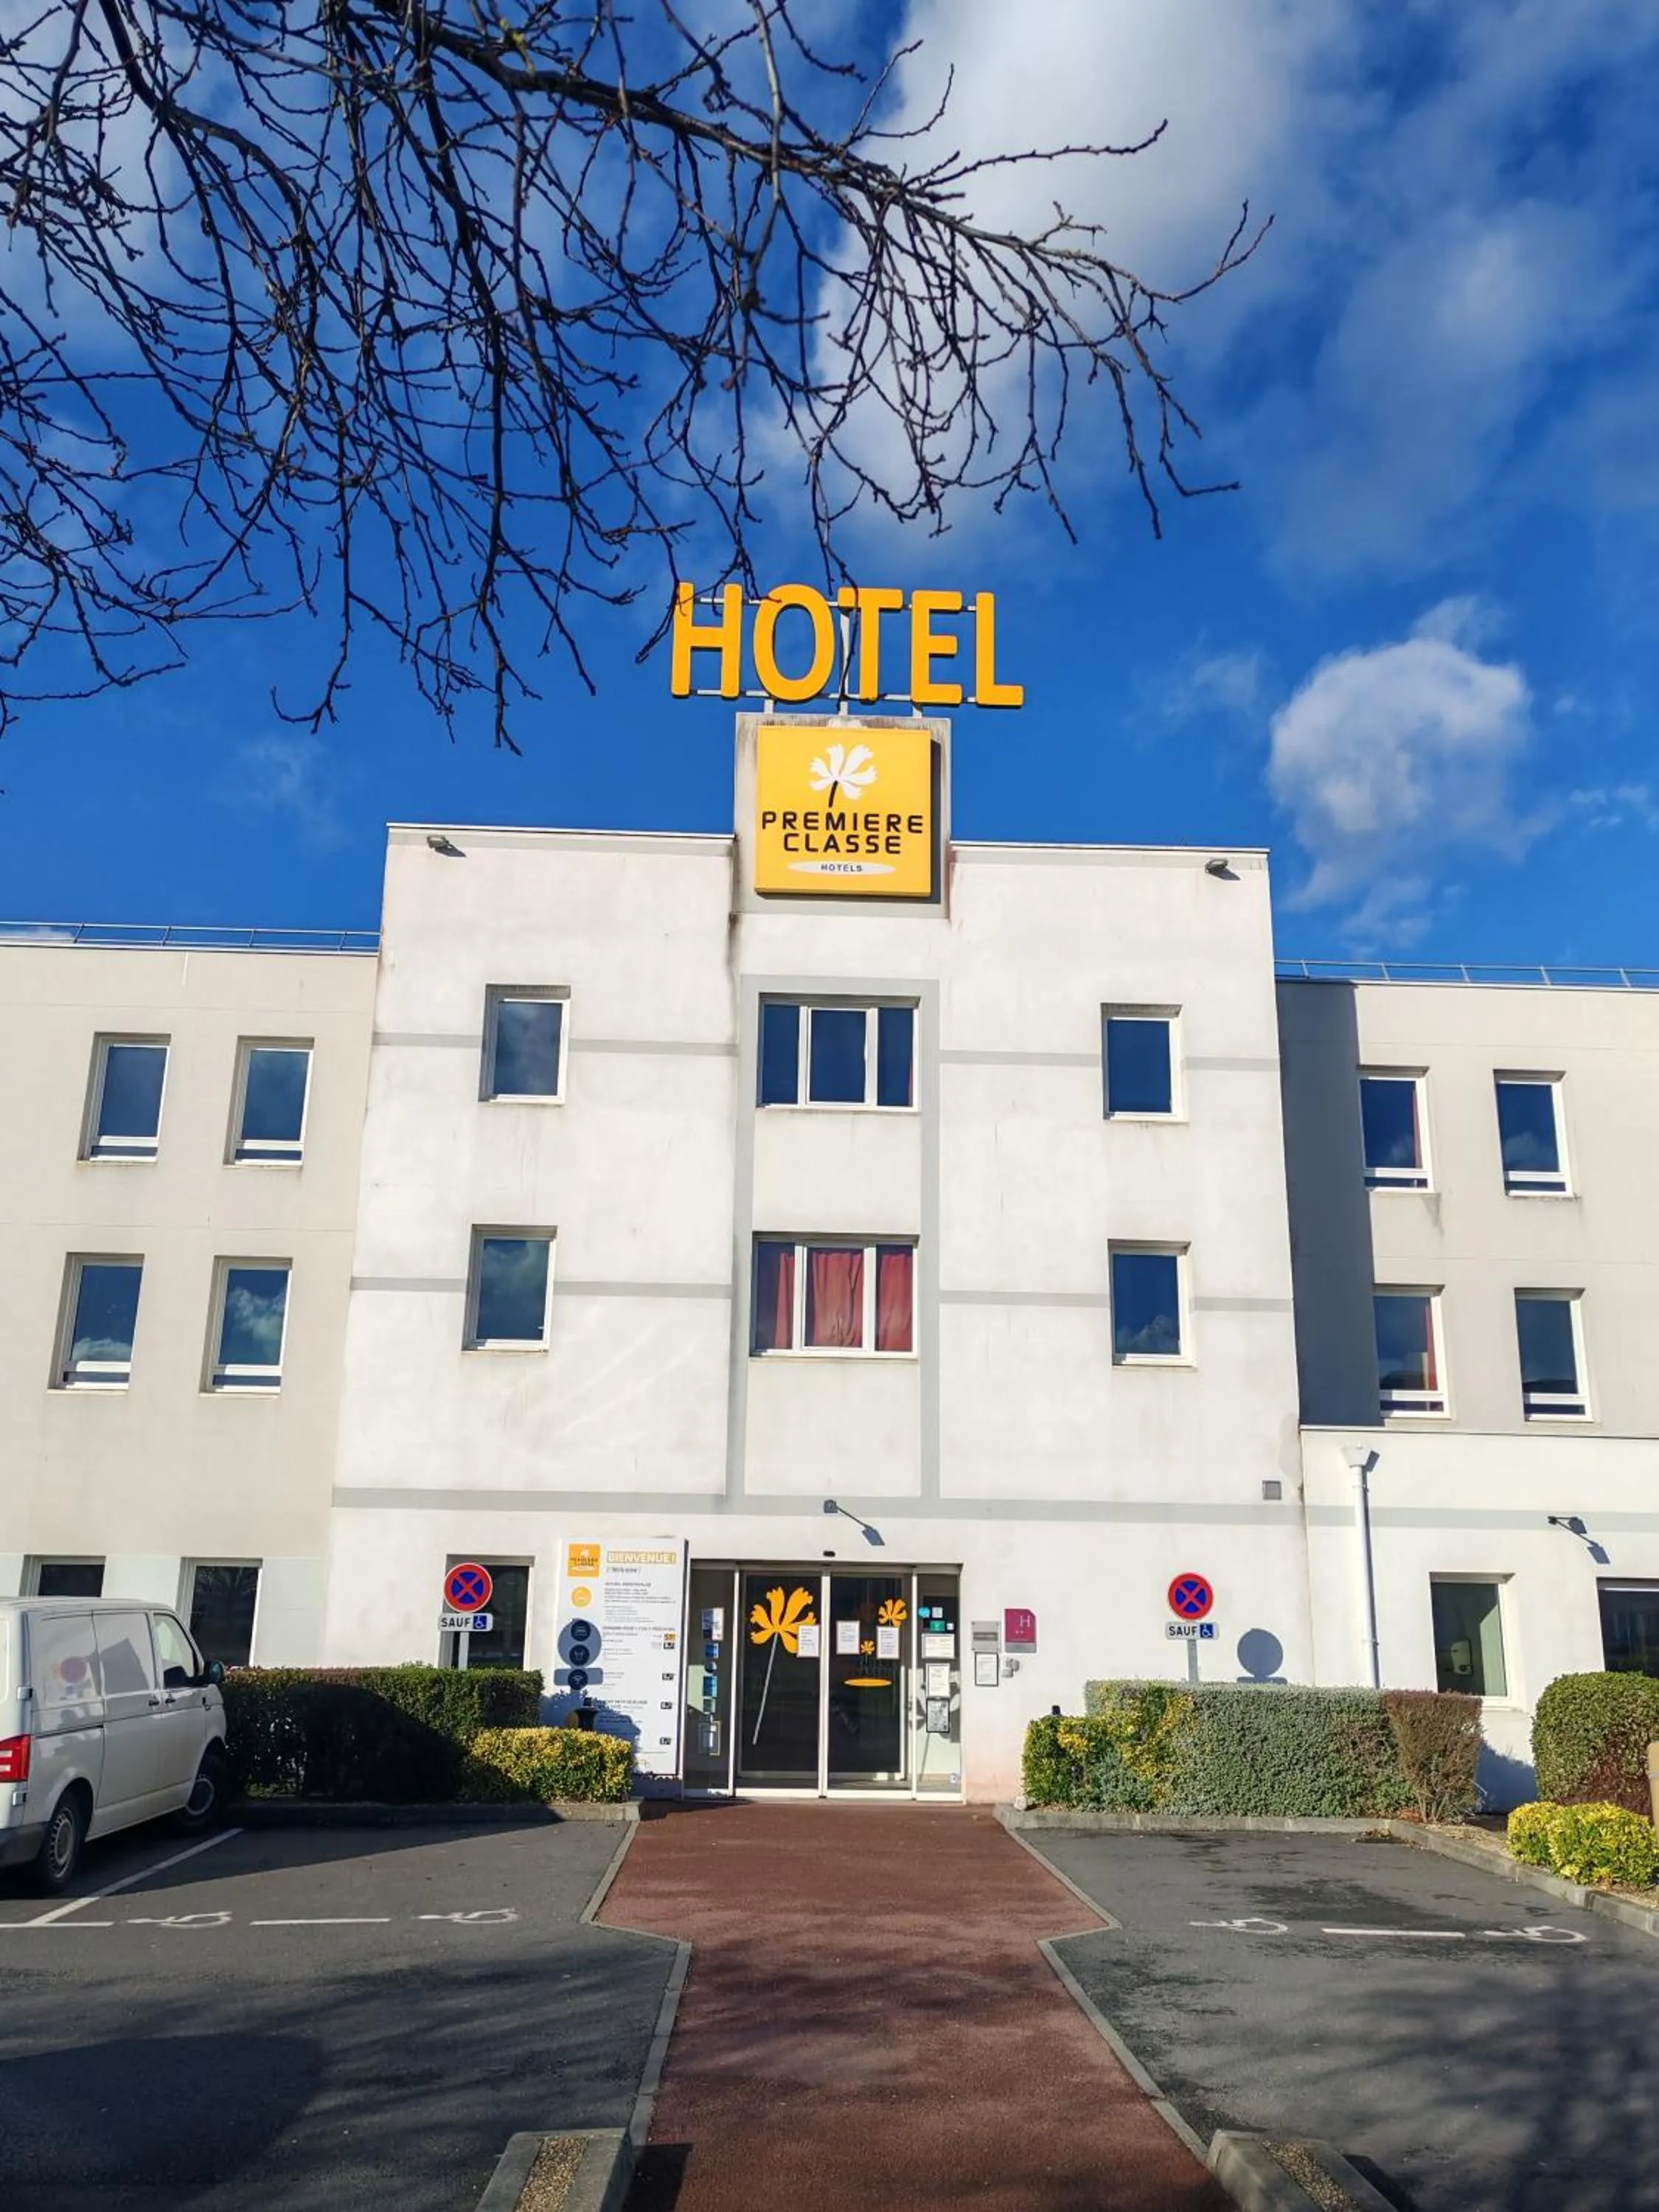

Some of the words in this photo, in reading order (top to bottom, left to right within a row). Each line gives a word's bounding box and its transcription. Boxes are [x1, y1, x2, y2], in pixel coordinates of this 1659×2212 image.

[672, 582, 1023, 706] HOTEL
[762, 811, 923, 834] PREMIERE
[784, 833, 901, 855] CLASSE
[821, 863, 862, 872] HOTELS
[441, 1617, 471, 1627] SAUF
[1169, 1626, 1197, 1636] SAUF
